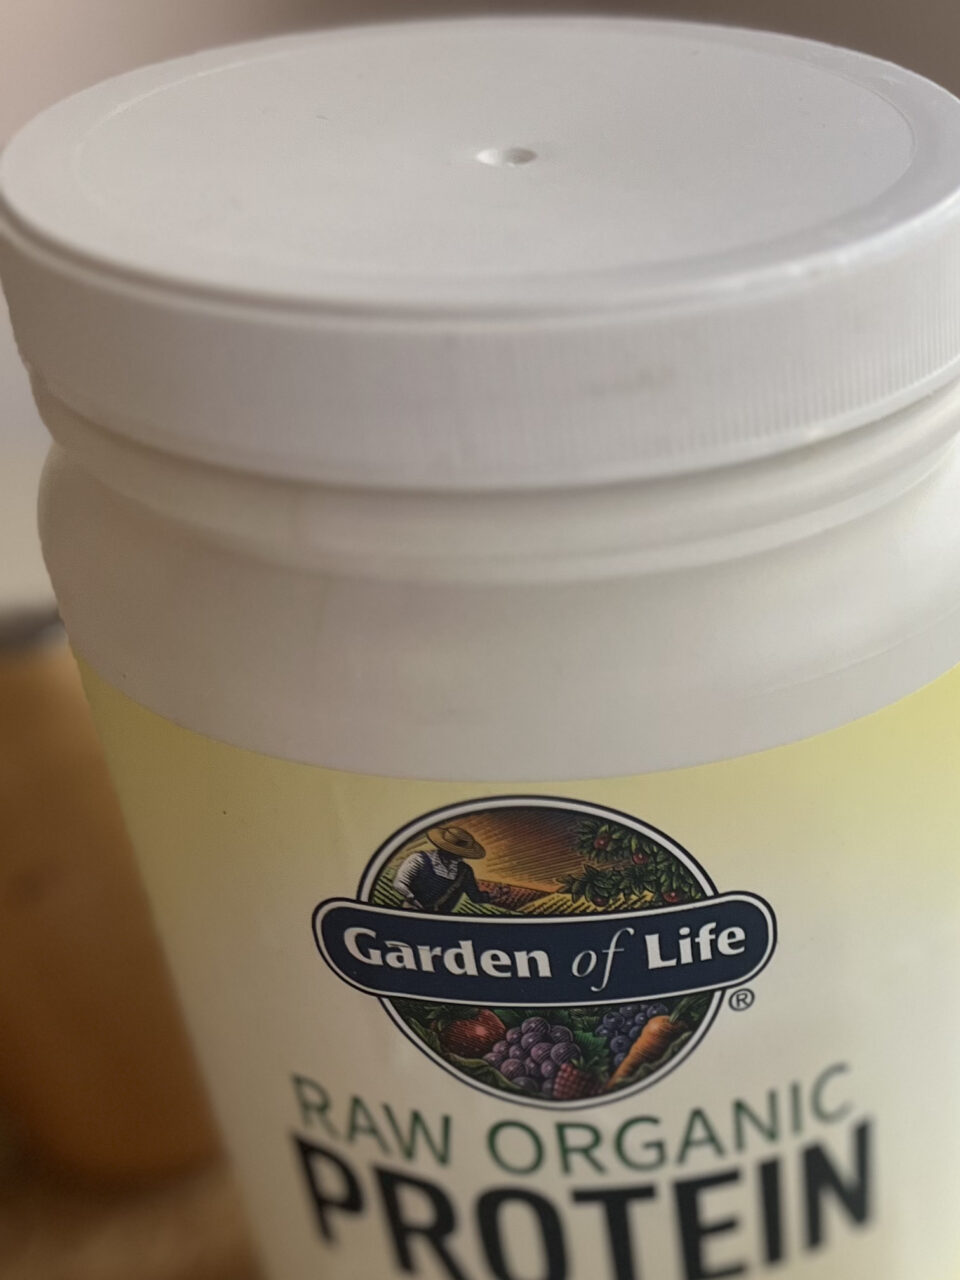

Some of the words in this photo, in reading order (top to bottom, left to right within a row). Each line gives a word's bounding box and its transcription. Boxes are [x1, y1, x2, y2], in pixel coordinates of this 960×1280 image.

[342, 924, 551, 978] Garden
[571, 926, 634, 992] of
[645, 921, 747, 970] Life
[292, 1074, 453, 1168] RAW
[487, 1062, 852, 1177] ORGANIC
